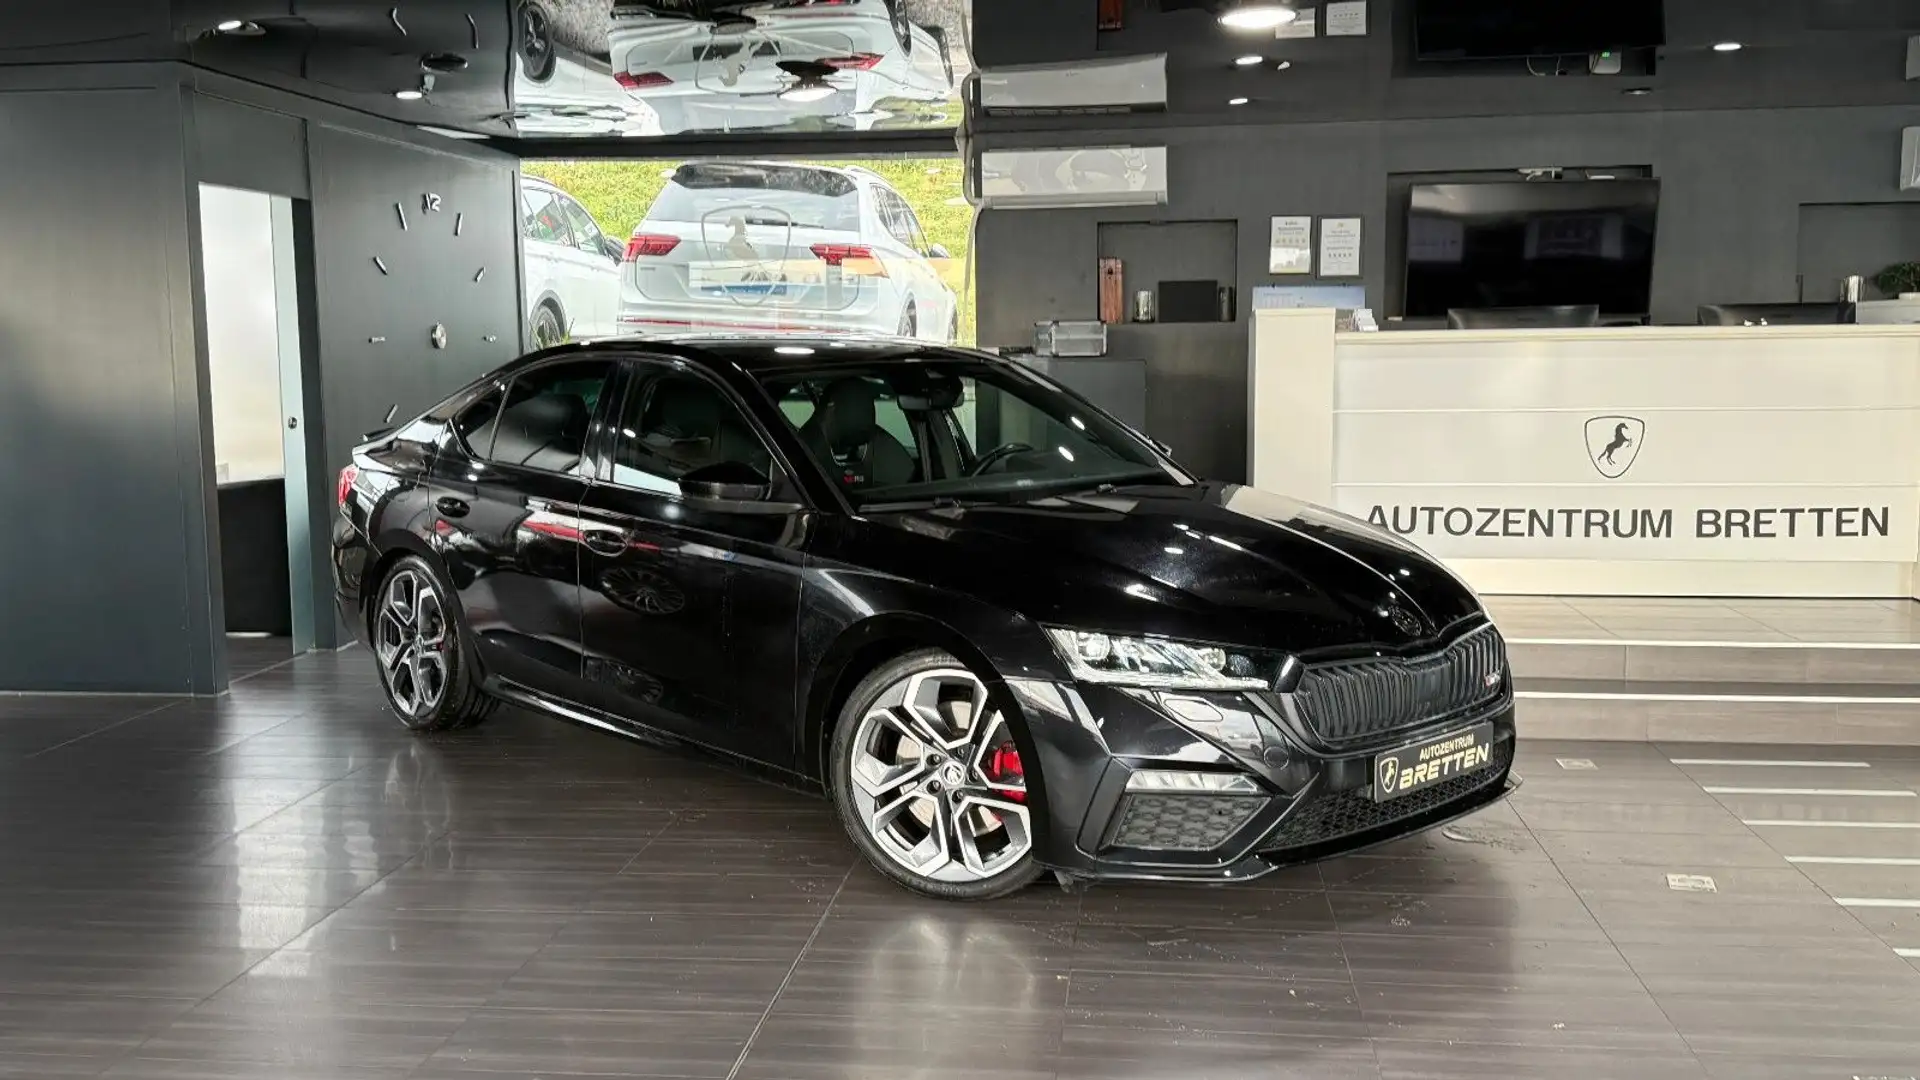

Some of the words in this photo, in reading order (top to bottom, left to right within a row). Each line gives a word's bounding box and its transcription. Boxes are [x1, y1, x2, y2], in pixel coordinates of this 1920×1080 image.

[423, 192, 441, 212] 12
[1367, 505, 1672, 538] AUTOZENTRUM
[1696, 506, 1889, 538] BRETTEN
[1419, 733, 1474, 761] AUTOZENTRUM
[1399, 742, 1490, 790] BRETTEN
